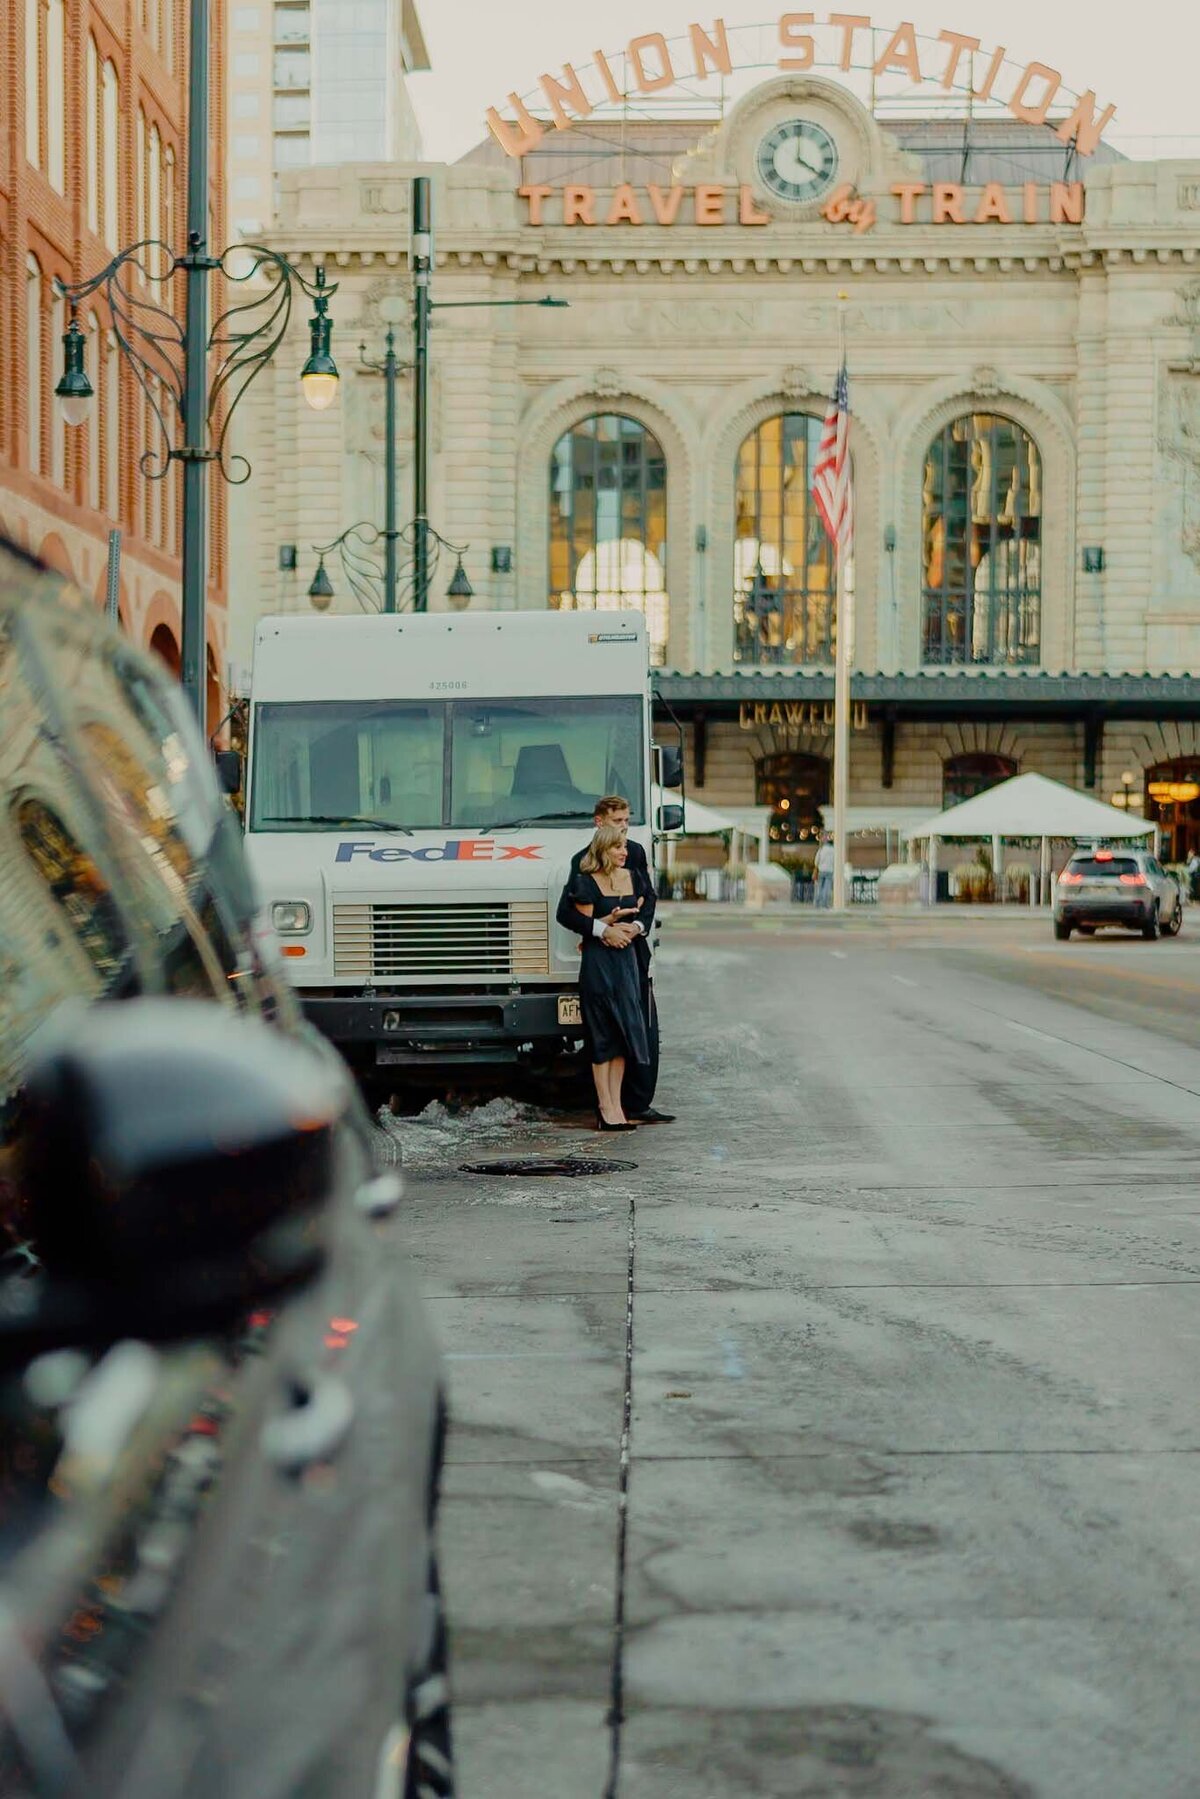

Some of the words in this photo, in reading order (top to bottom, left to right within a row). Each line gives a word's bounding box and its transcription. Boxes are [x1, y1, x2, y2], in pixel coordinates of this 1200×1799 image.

[486, 19, 732, 157] UNION
[778, 13, 1117, 155] STATION
[519, 183, 769, 226] TRAVEL
[820, 184, 877, 235] by
[891, 183, 1084, 225] TRAIN
[739, 702, 869, 730] CRAWFOD
[335, 840, 544, 863] FedEx
